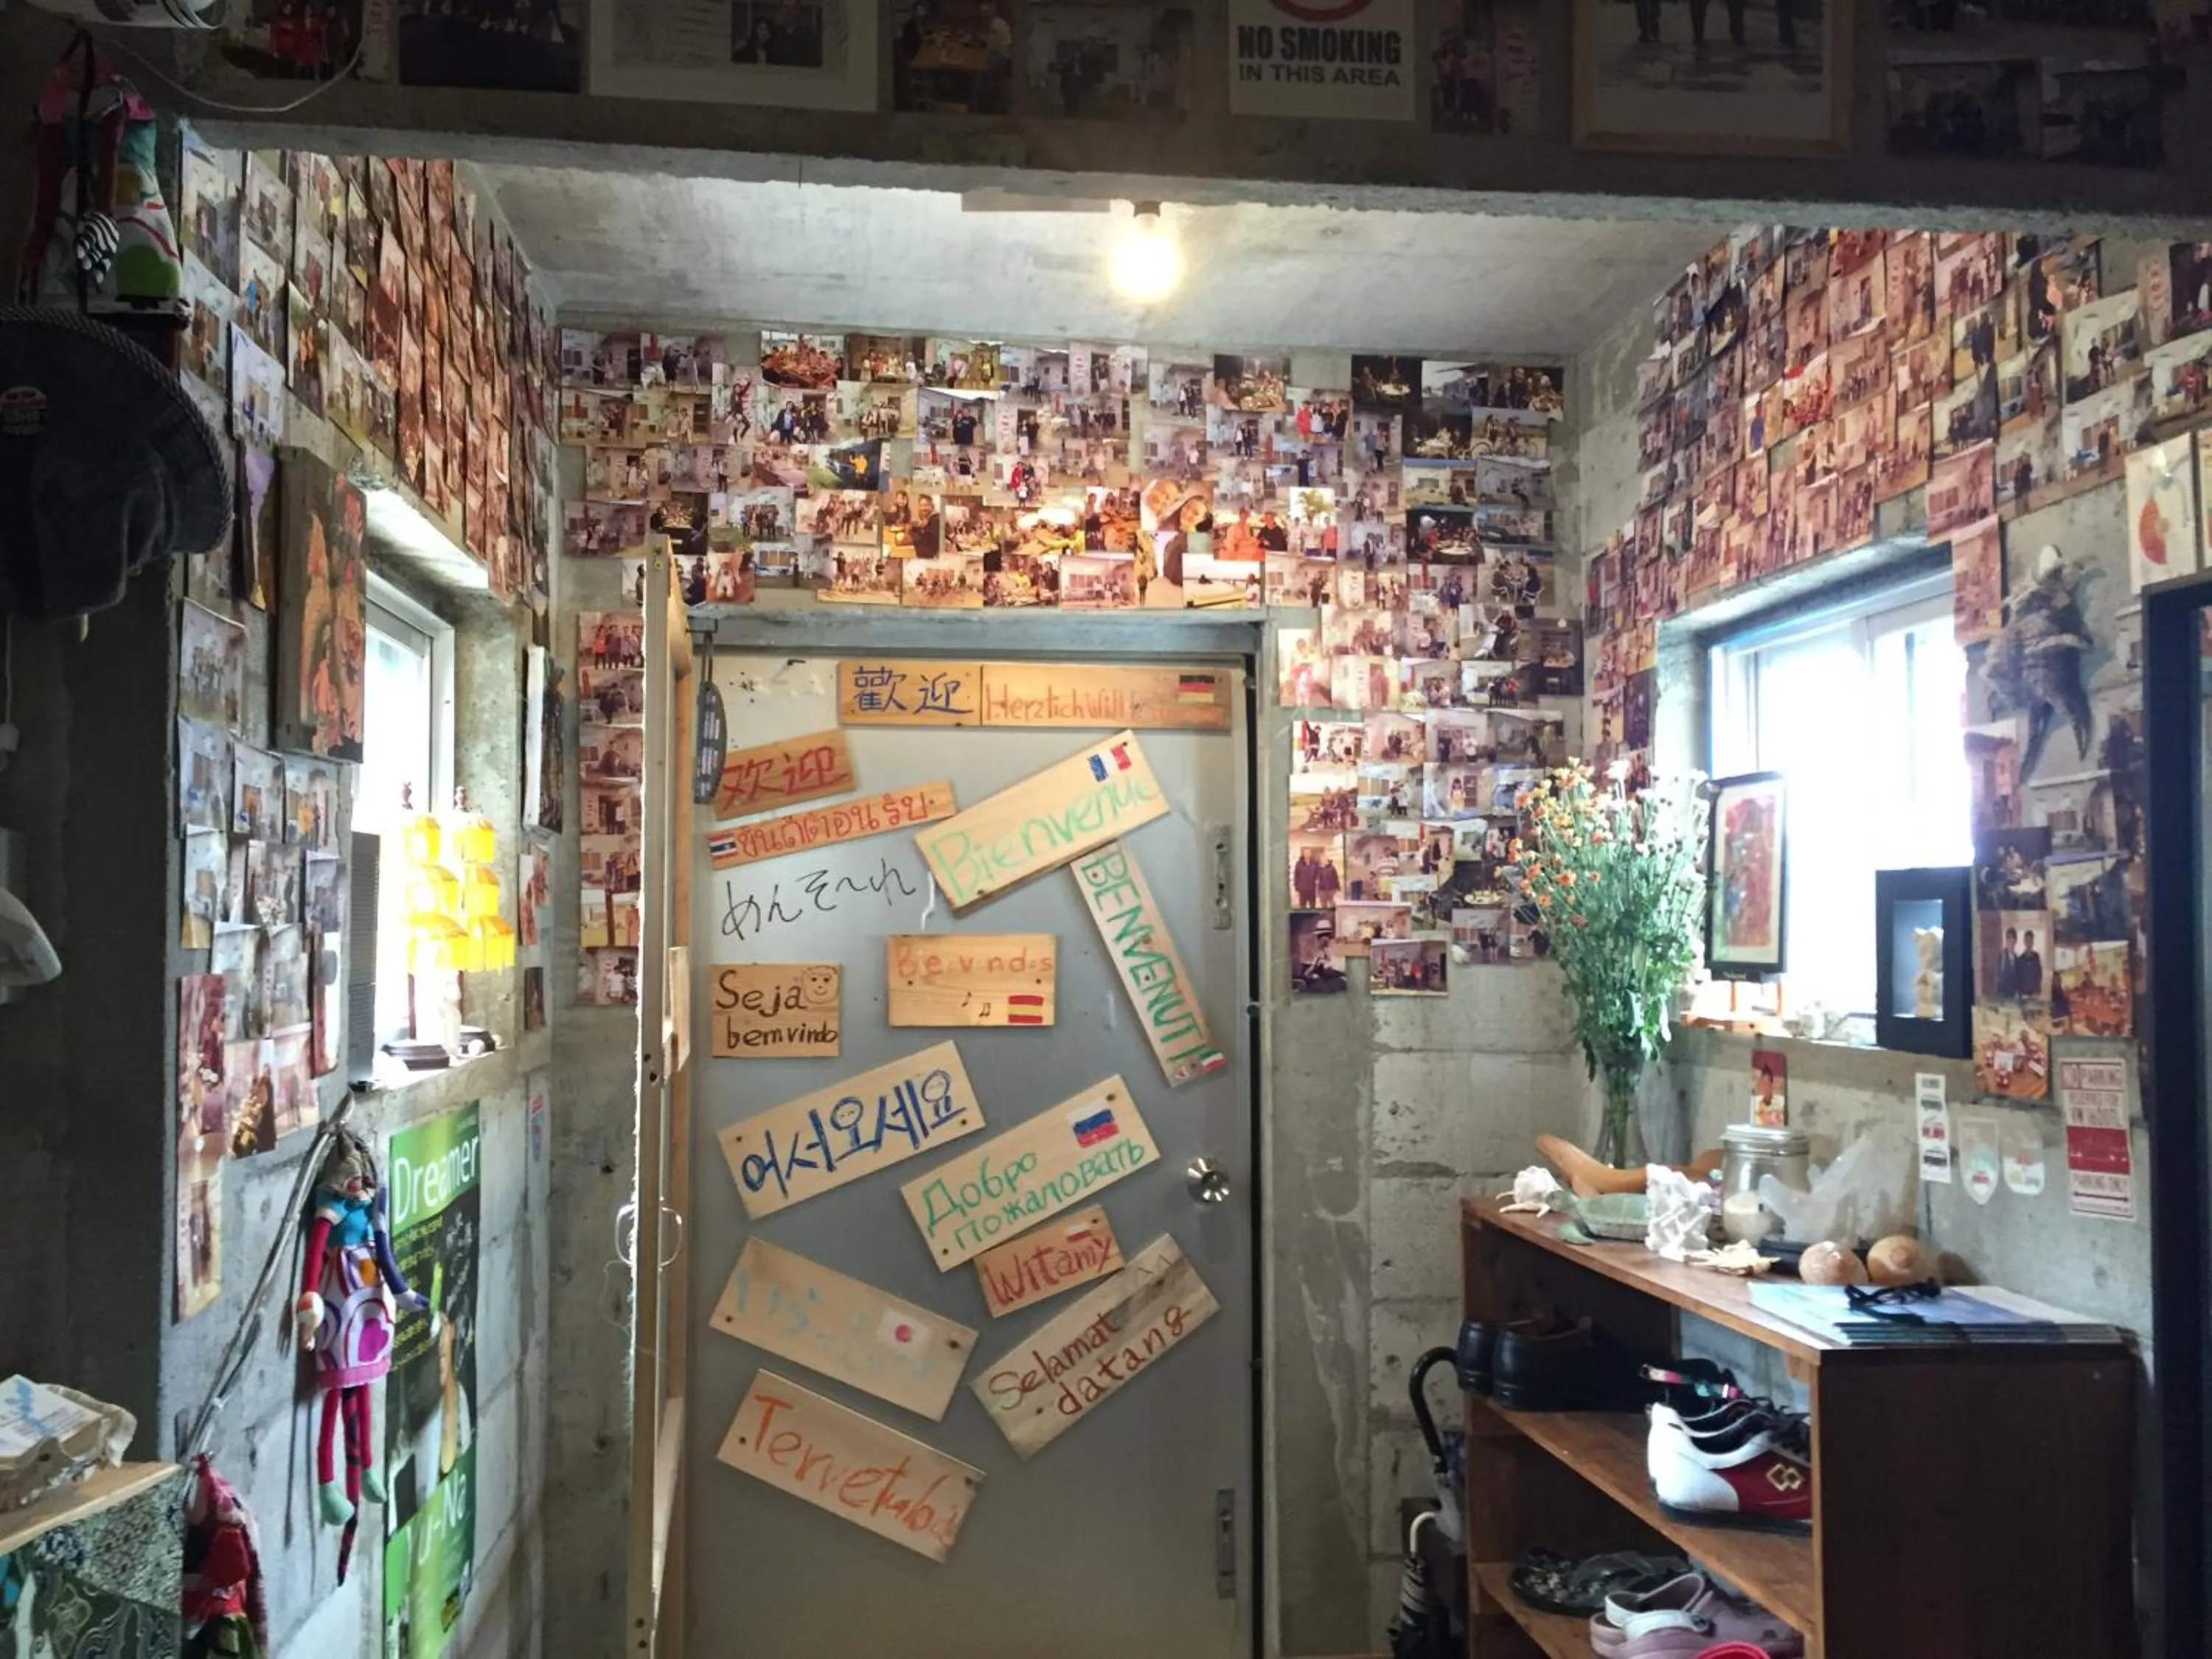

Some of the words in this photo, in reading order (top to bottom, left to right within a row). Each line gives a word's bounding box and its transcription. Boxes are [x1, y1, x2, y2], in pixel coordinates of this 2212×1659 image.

[1238, 25, 1274, 59] NO
[1280, 27, 1402, 65] SMOKING
[1239, 63, 1262, 81] IN
[1270, 64, 1326, 83] THIS
[1332, 66, 1400, 87] AREA
[853, 665, 973, 714] 歡迎
[722, 745, 851, 811] 欢迎
[929, 776, 1158, 901] Bienvenue
[715, 969, 808, 1018] Seja
[1080, 848, 1208, 1064] BENVENUTI
[394, 1135, 479, 1225] Dreamer
[922, 1152, 1037, 1237] Добро
[954, 1138, 1145, 1250] пожаловать
[984, 1237, 1111, 1305] Witamy
[989, 1312, 1116, 1410] Selamat
[1058, 1307, 1191, 1416] datang
